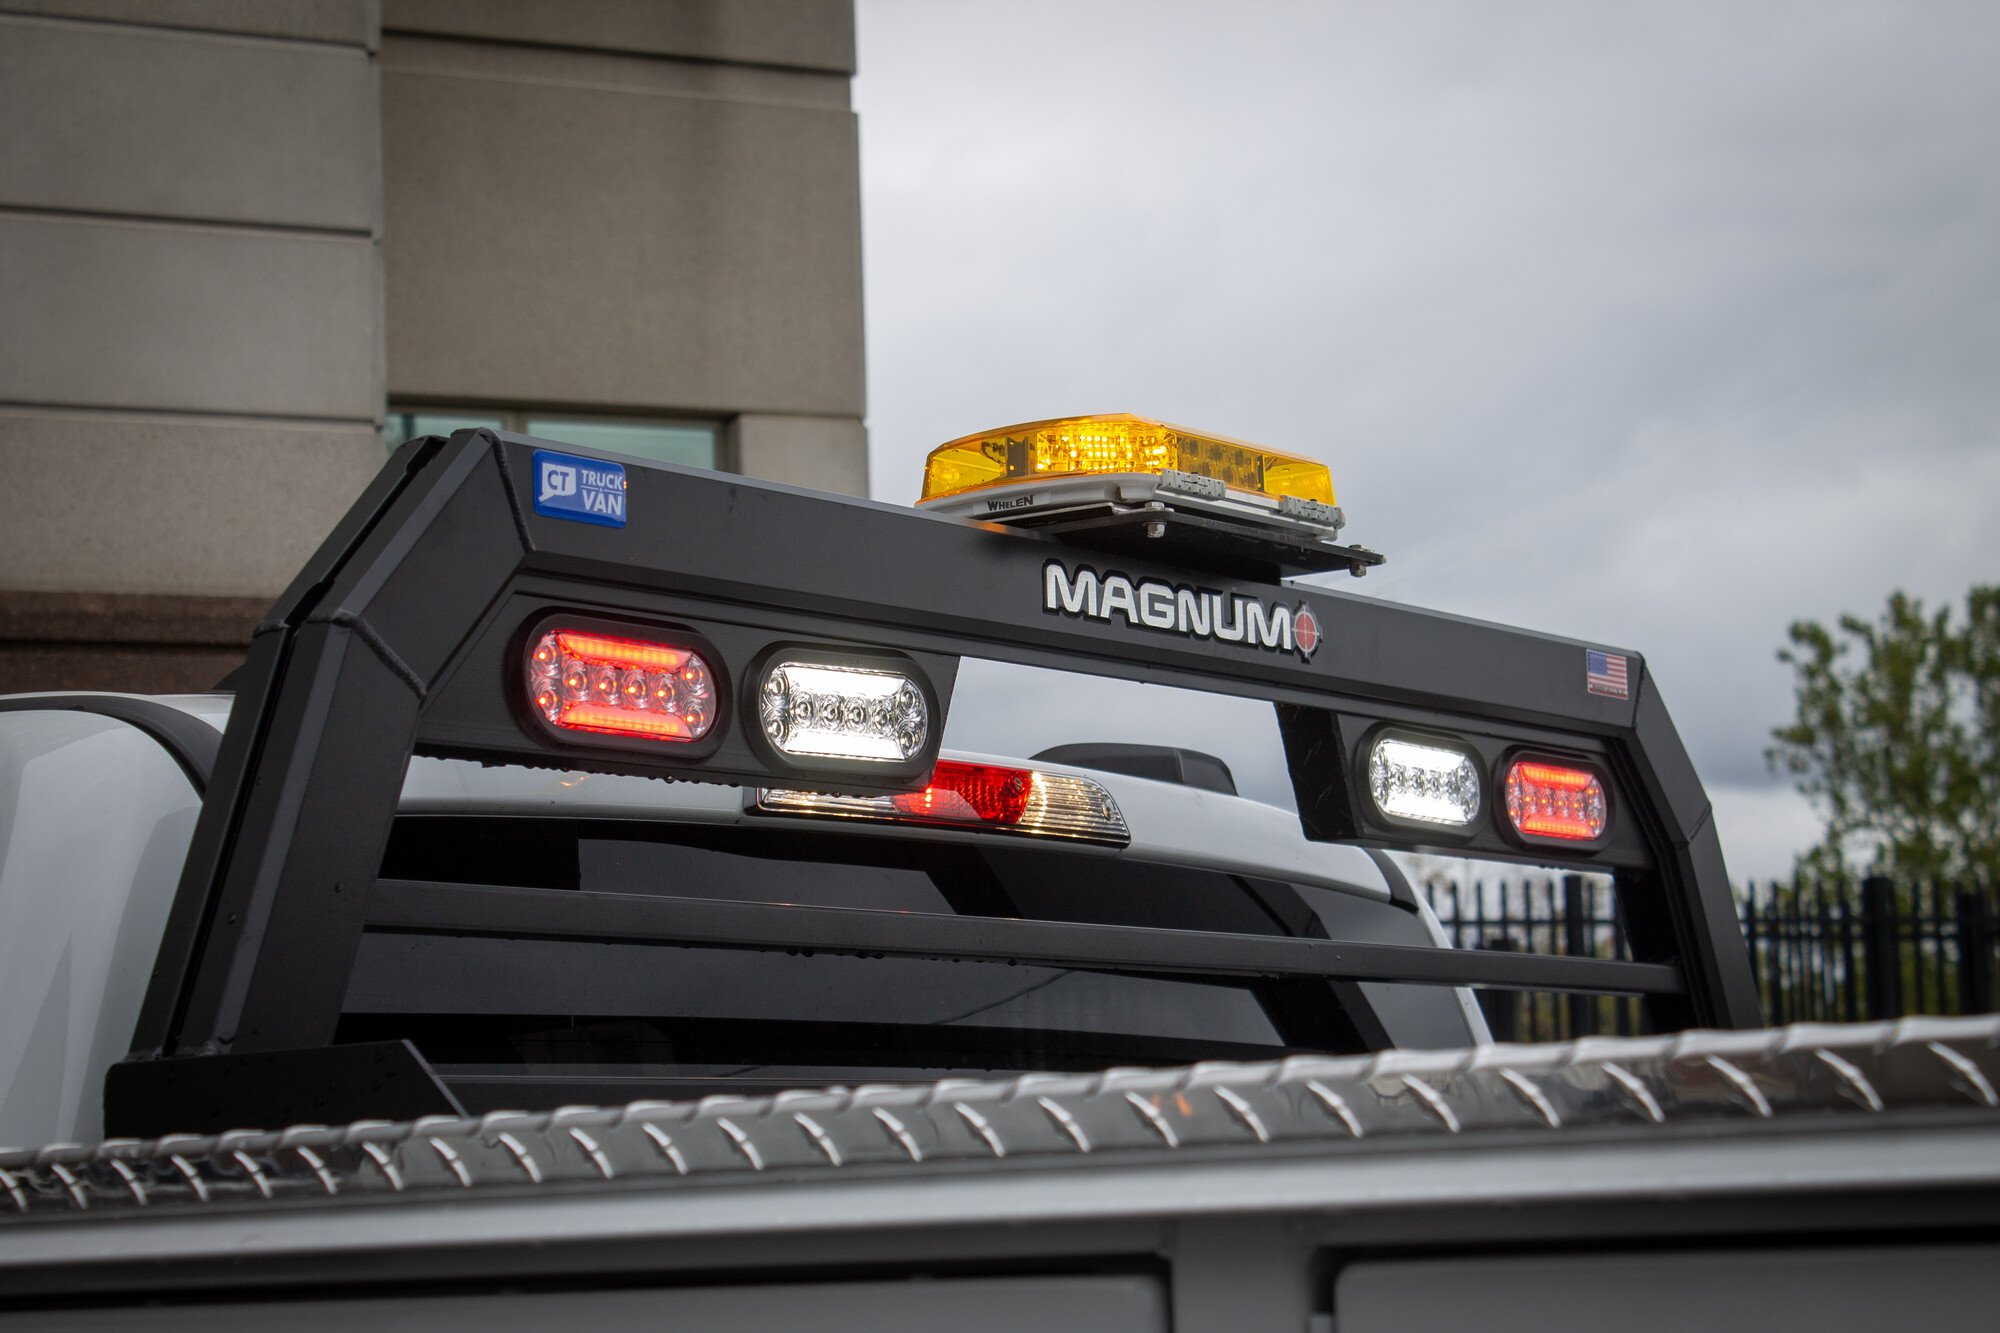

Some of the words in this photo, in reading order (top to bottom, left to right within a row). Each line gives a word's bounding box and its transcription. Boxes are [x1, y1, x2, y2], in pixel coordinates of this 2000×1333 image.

[547, 469, 570, 492] CT
[581, 469, 623, 491] TRUCK
[582, 489, 623, 516] VAN
[987, 494, 1034, 511] WHELEN
[1046, 563, 1293, 651] MAGNUM
